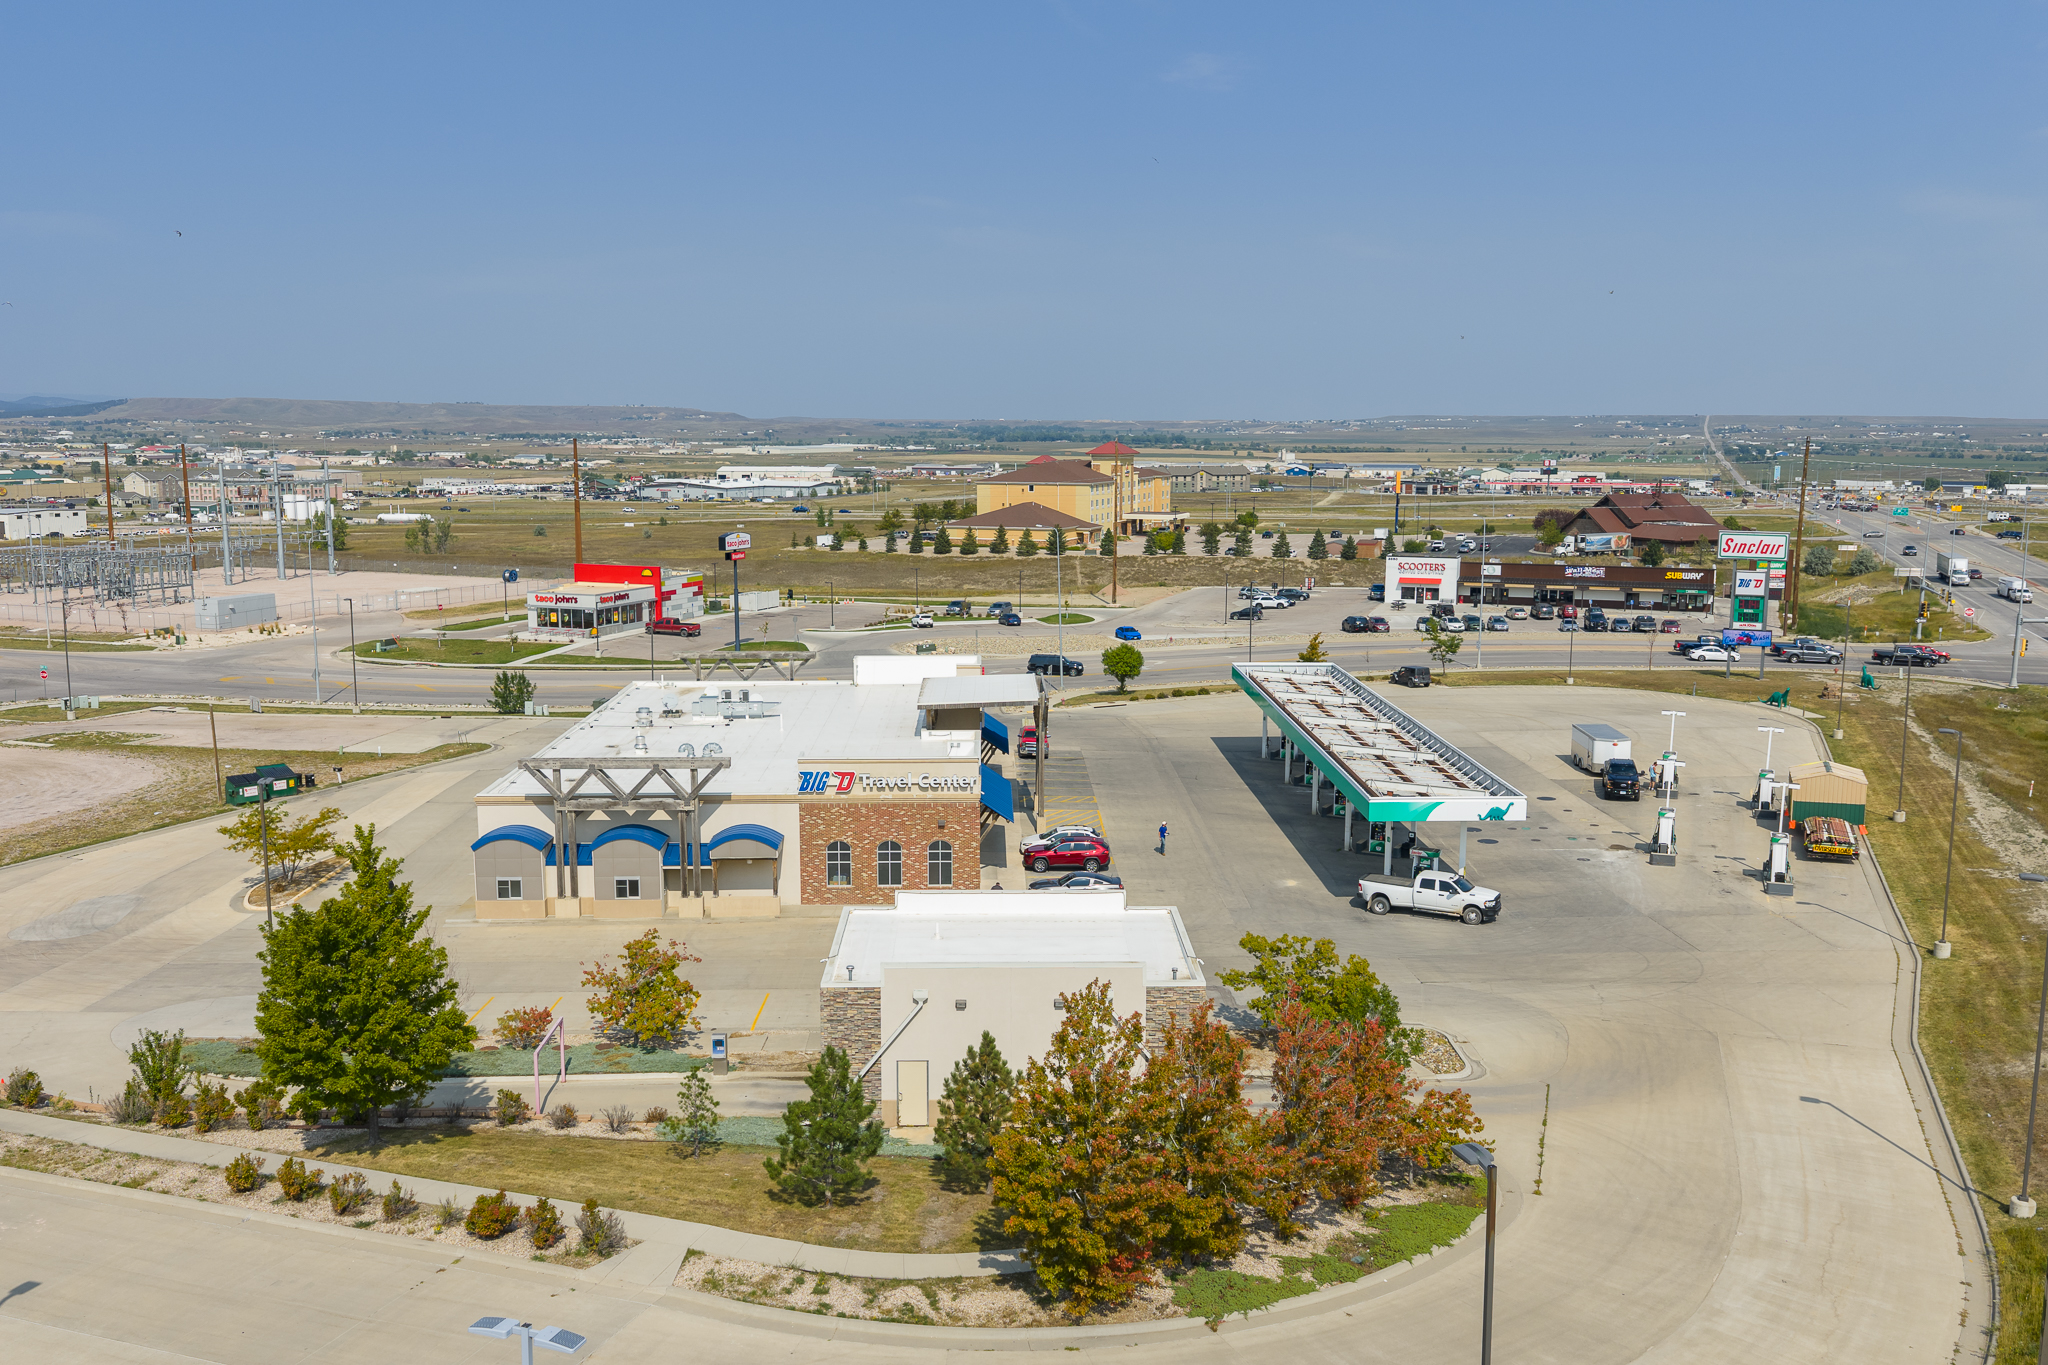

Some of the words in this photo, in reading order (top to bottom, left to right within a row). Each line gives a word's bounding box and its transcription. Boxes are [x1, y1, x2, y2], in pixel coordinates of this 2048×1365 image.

[737, 539, 750, 548] john's
[1722, 538, 1784, 555] Sinclair
[1398, 562, 1446, 571] SCOOTER'S
[1664, 571, 1704, 580] SUBWAY
[1738, 579, 1752, 588] BIG
[1753, 579, 1764, 588] D
[535, 594, 554, 603] taco
[555, 594, 578, 605] john's
[600, 595, 614, 604] taco
[614, 592, 630, 603] john's
[798, 771, 830, 793] BIG
[833, 771, 856, 793] D
[859, 772, 912, 788] Travel
[918, 773, 978, 789] Center
